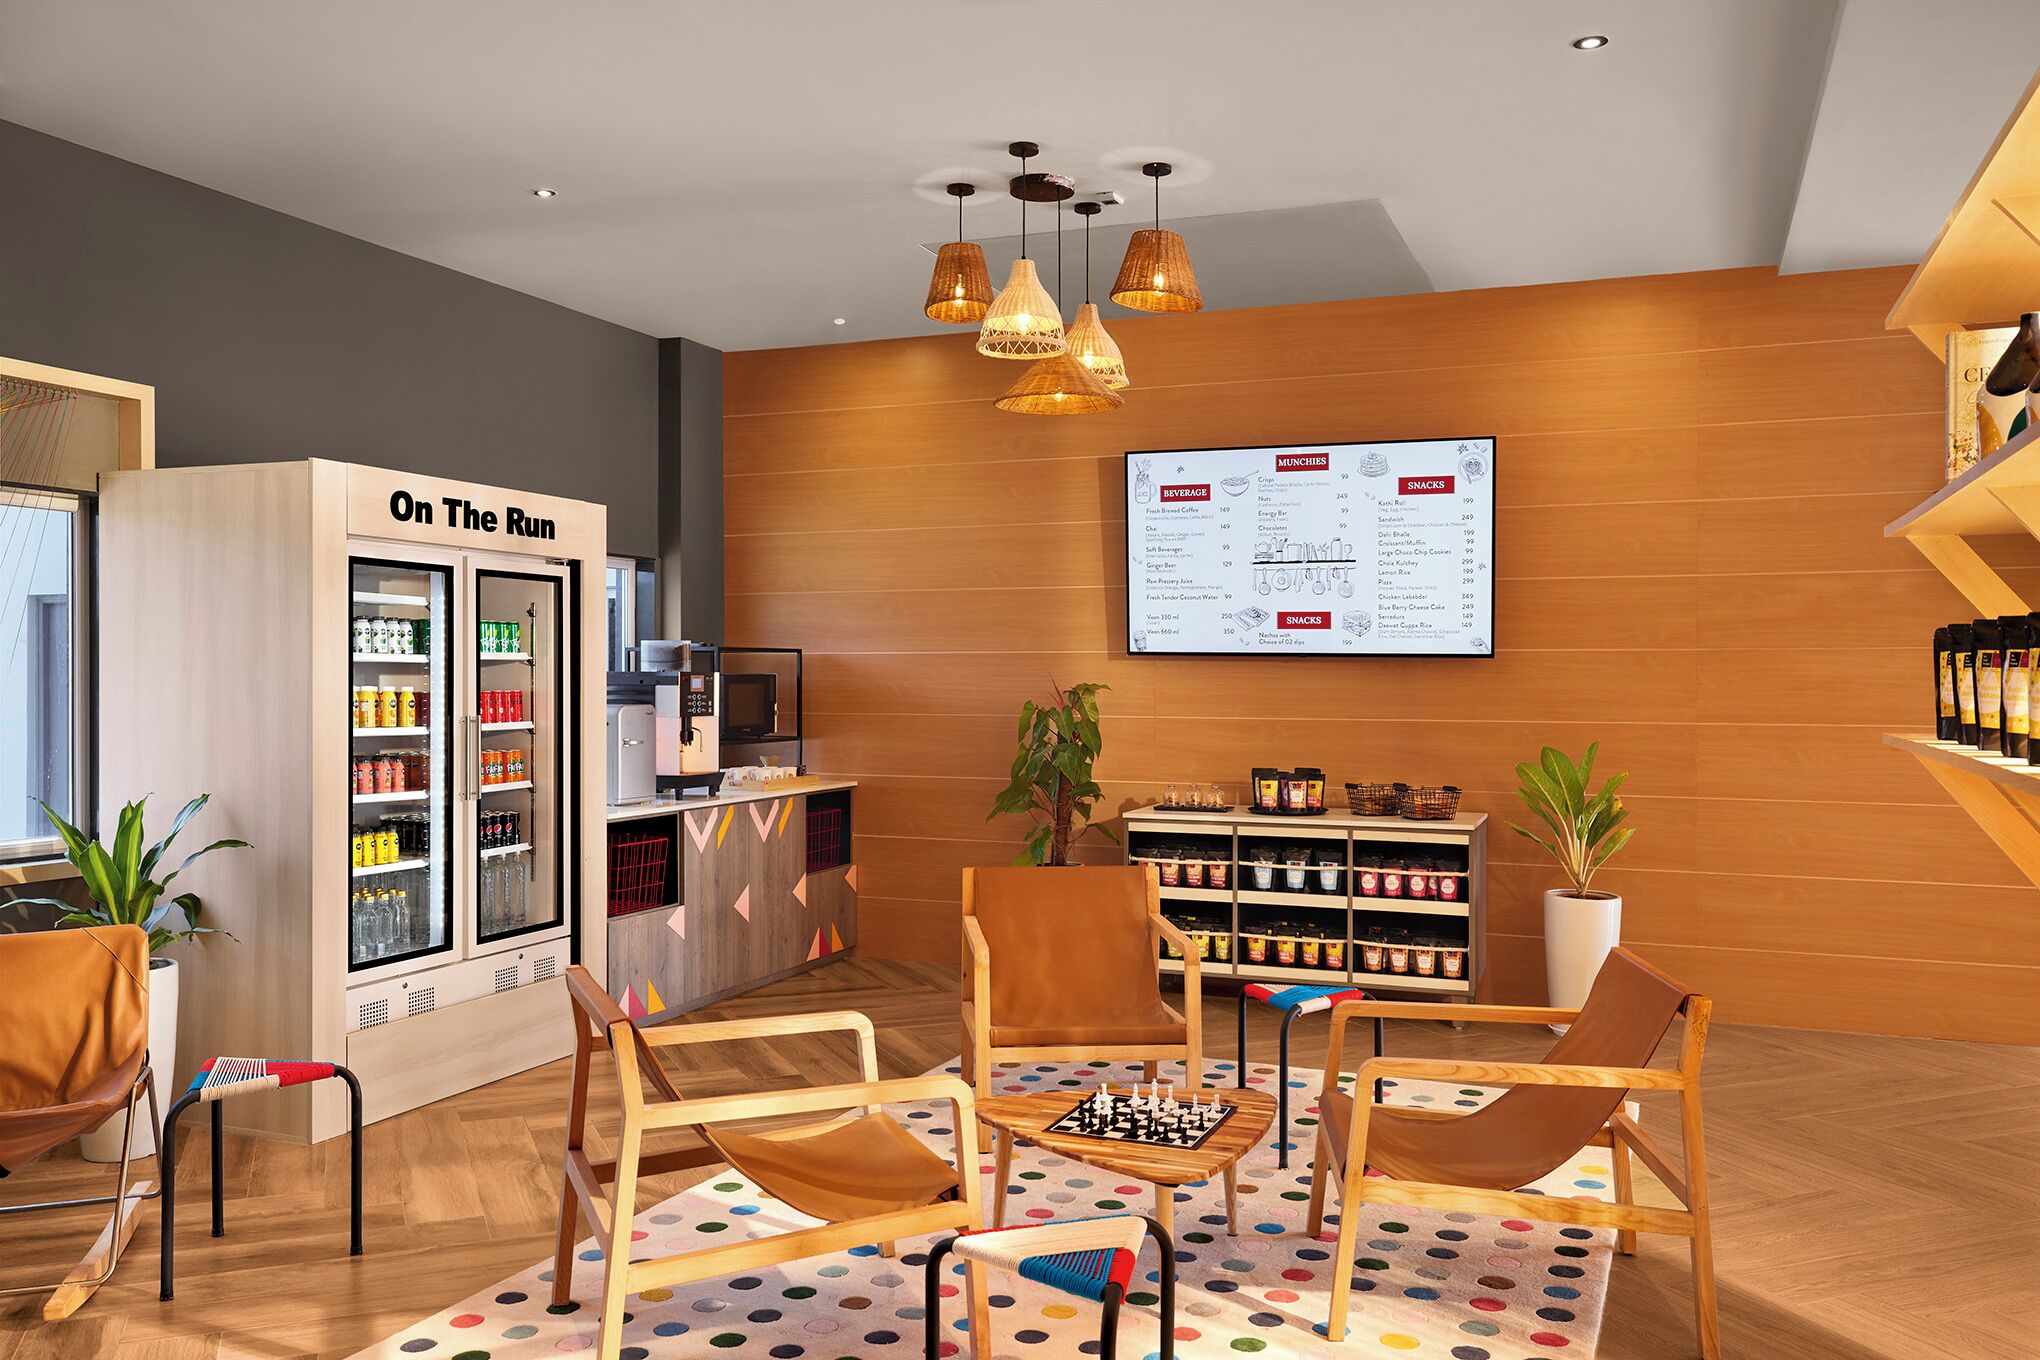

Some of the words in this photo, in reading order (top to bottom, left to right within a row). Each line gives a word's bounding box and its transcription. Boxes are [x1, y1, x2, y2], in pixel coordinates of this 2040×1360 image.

[1278, 457, 1326, 467] MUNCHIES
[1408, 480, 1445, 490] SNACKS
[1164, 489, 1207, 497] BEVERAGE
[390, 490, 433, 525] On
[442, 497, 498, 533] The
[506, 506, 555, 540] Run
[1286, 616, 1322, 625] SNACKS
